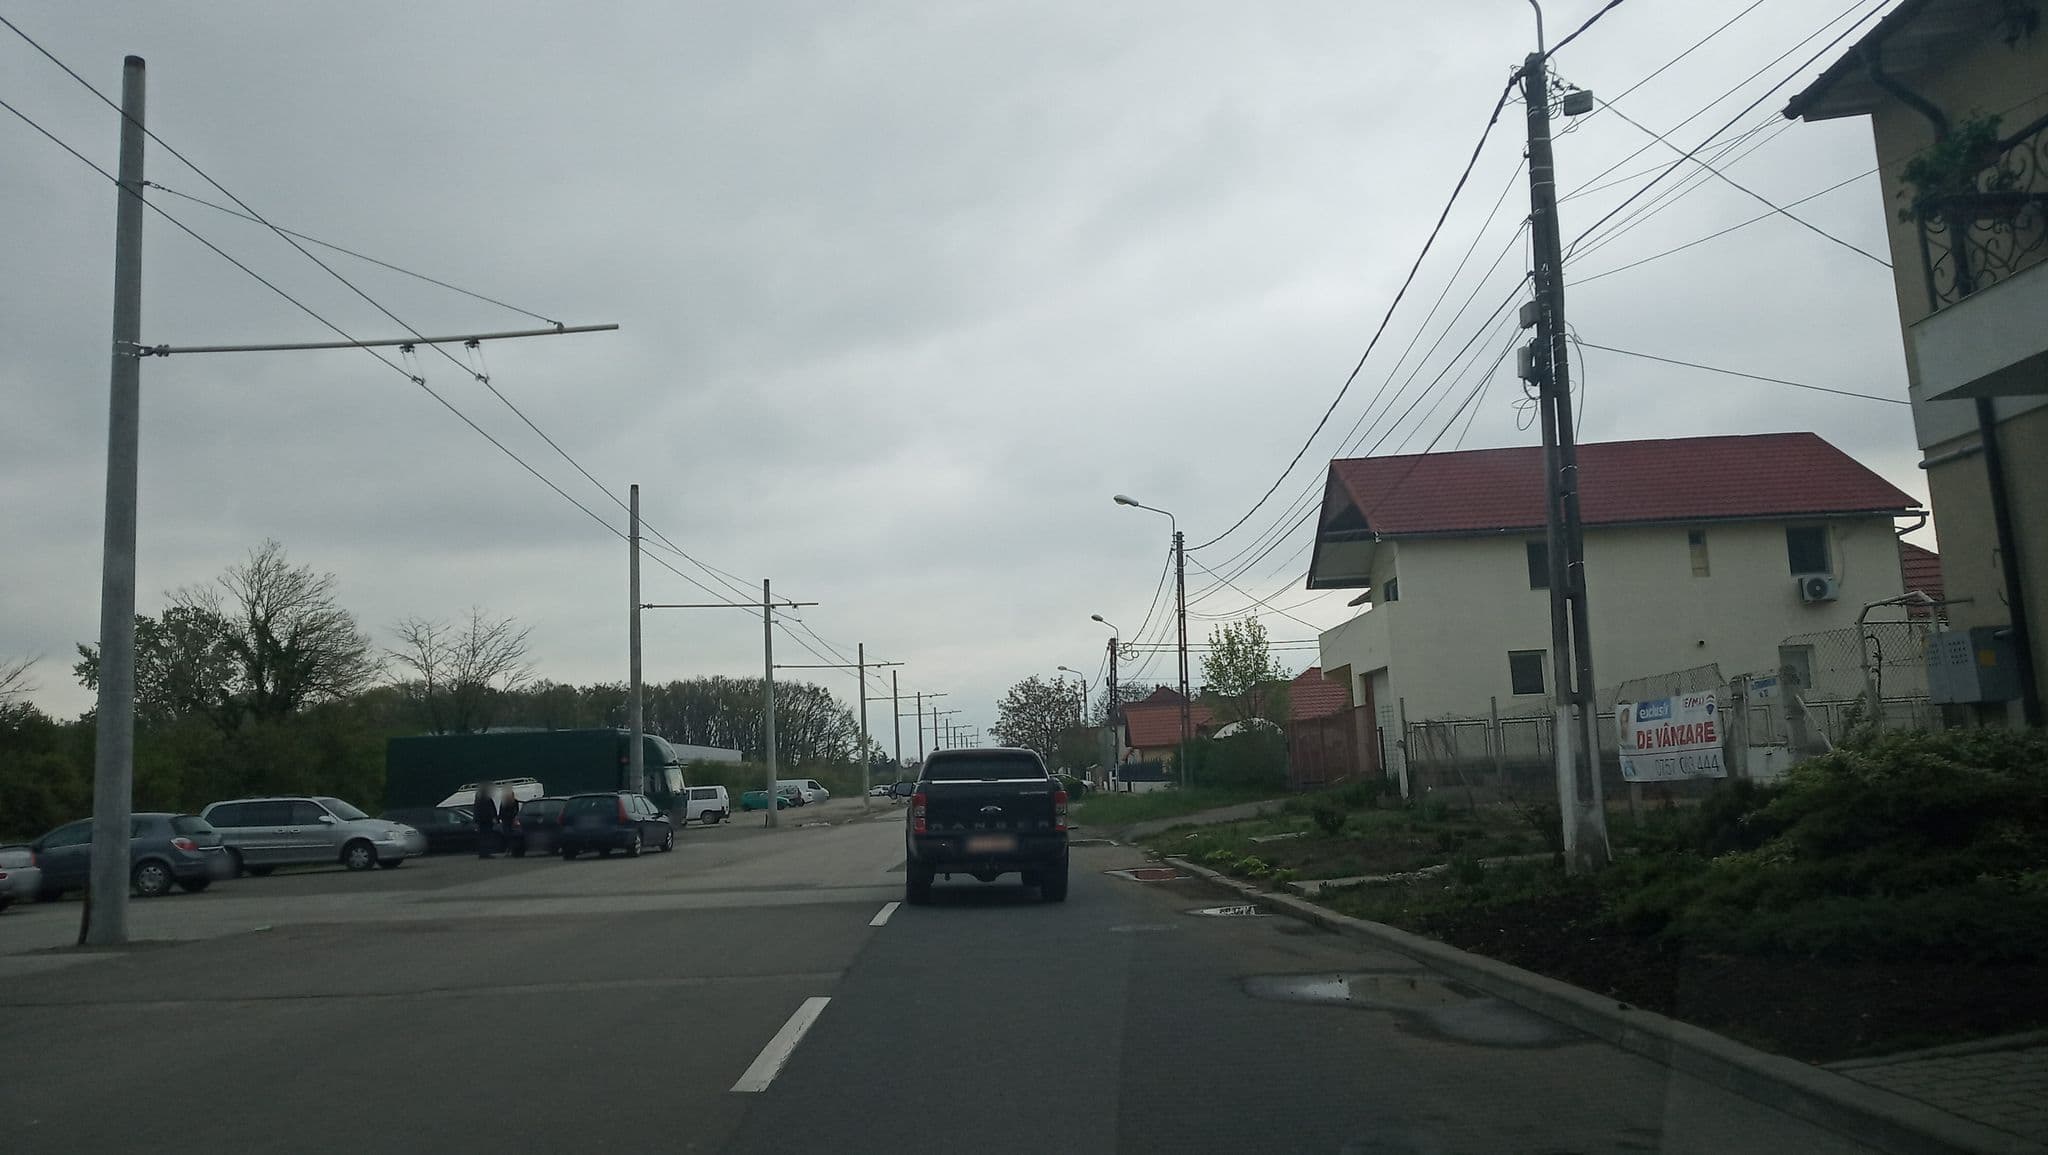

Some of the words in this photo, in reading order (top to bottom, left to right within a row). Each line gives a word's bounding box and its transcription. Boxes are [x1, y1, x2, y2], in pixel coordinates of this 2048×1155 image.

[1636, 729, 1652, 749] DE
[1655, 721, 1717, 747] VÂNZARE
[1697, 754, 1719, 772] 444
